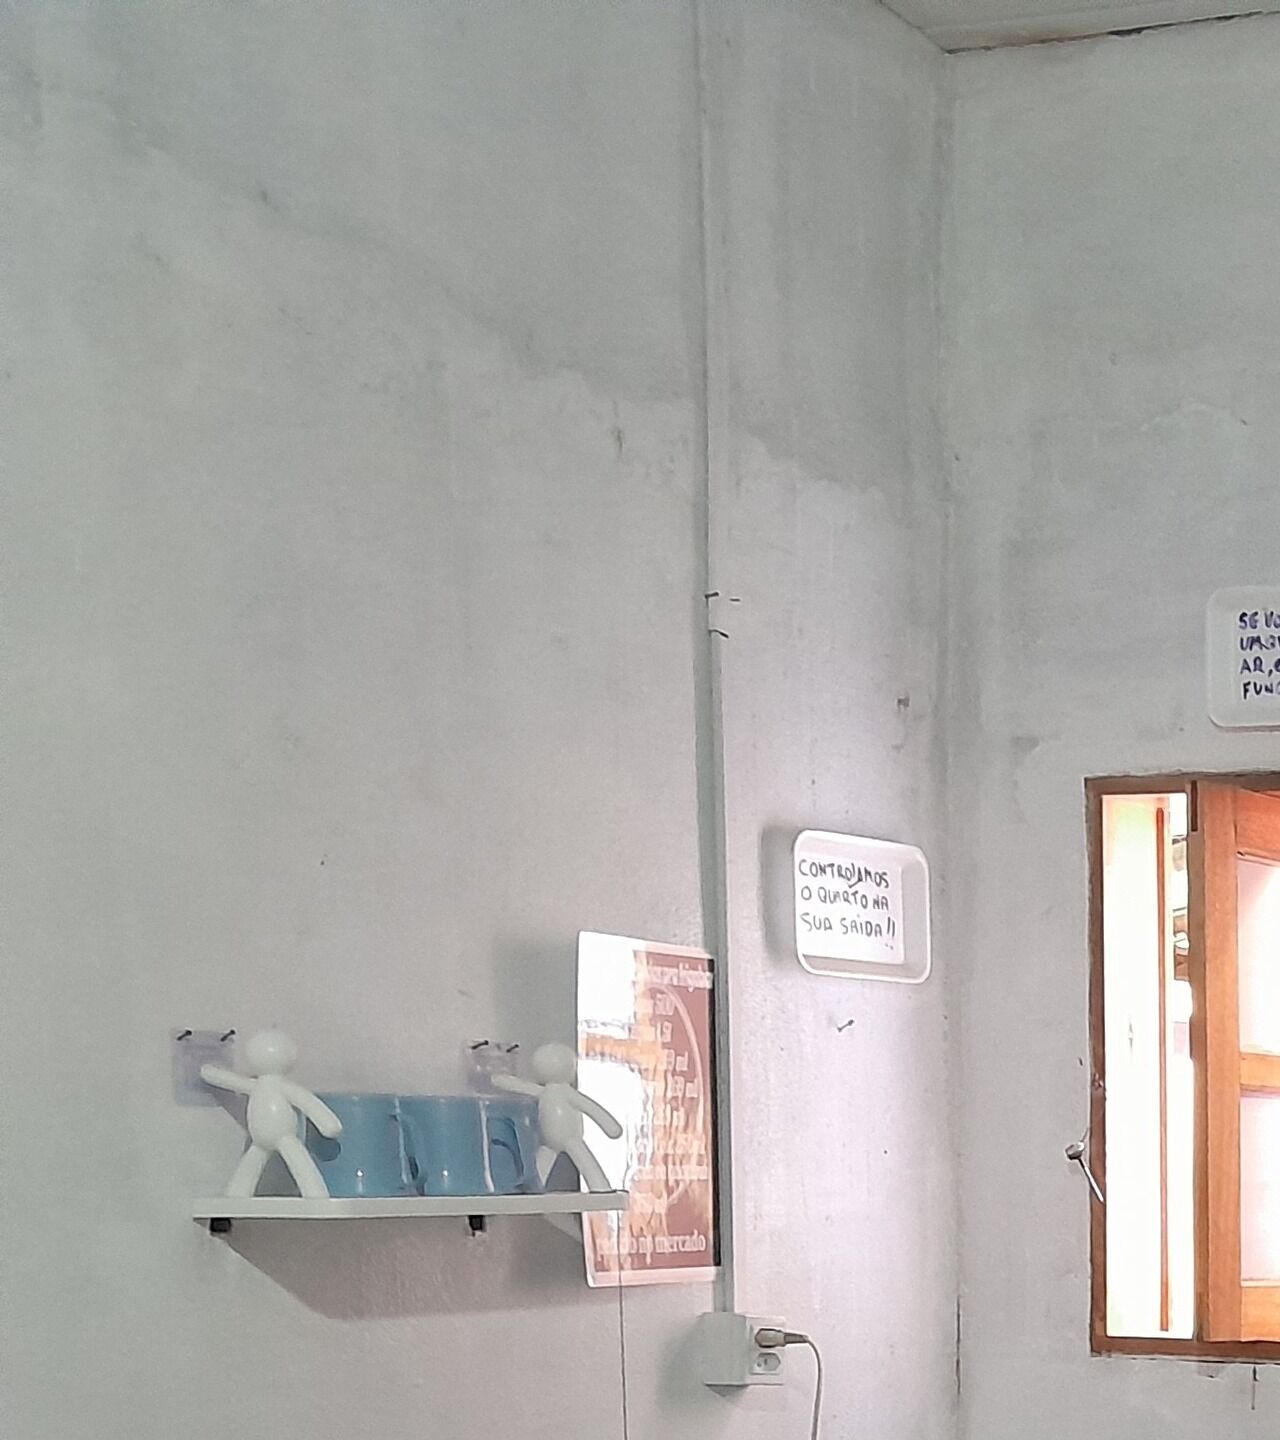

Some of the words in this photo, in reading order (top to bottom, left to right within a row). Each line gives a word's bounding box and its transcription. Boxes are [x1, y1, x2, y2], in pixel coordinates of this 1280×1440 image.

[1239, 611, 1259, 630] SE
[801, 885, 812, 901] O
[817, 886, 868, 910] QUARTO
[872, 894, 890, 911] NA
[800, 912, 833, 932] SUA
